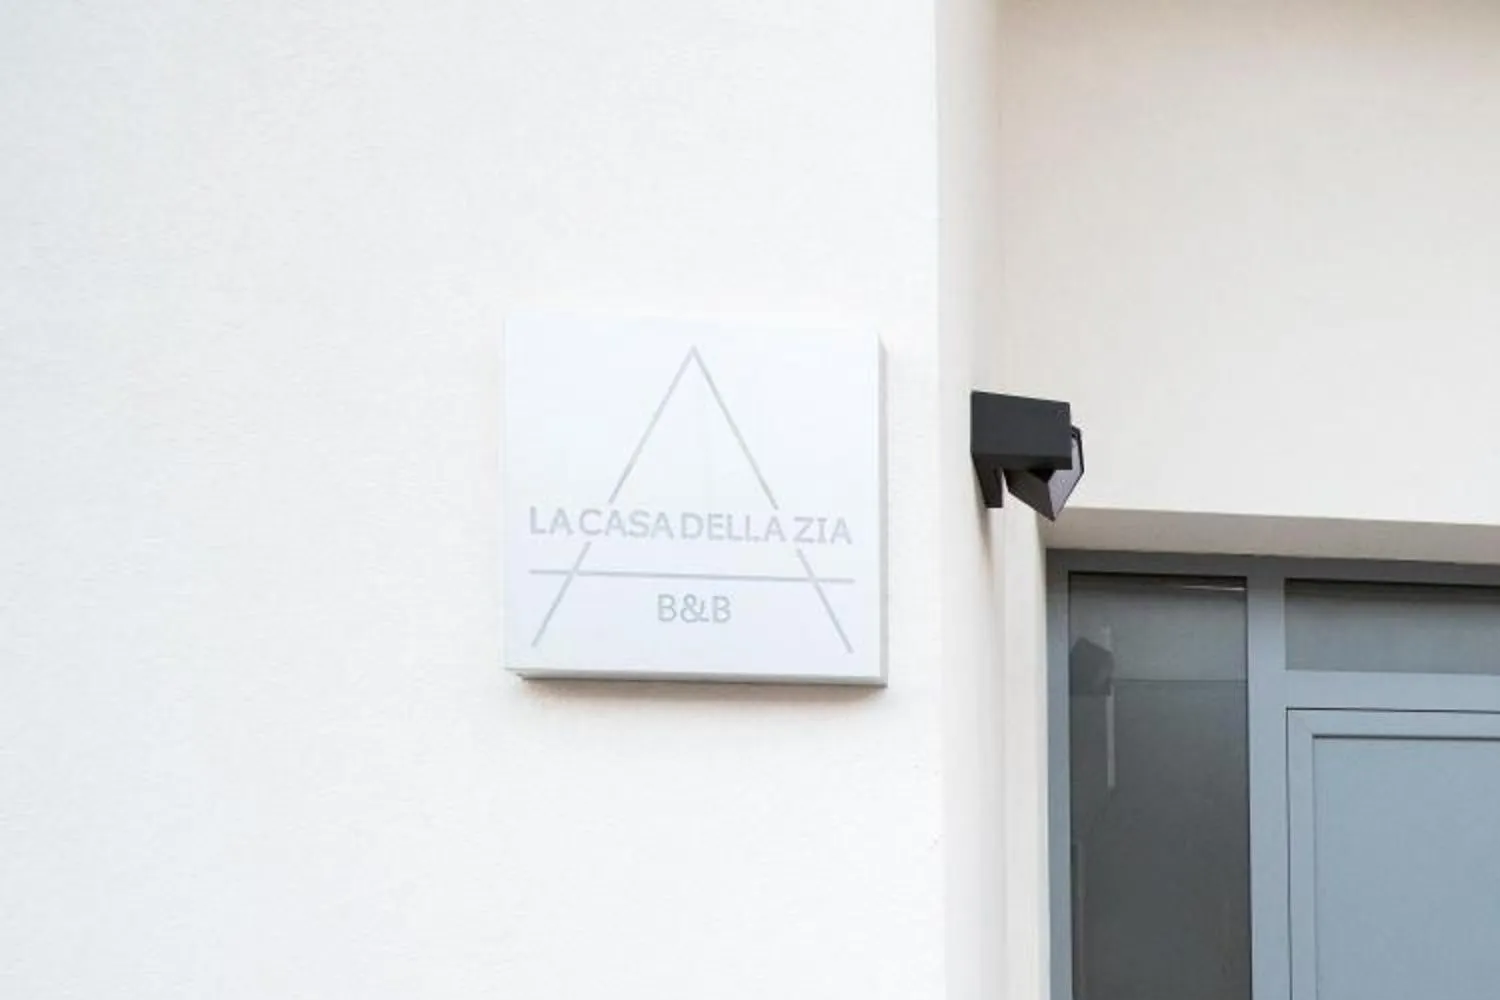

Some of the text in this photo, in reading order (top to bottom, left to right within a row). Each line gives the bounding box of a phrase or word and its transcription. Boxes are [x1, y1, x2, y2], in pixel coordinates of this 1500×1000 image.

[530, 507, 853, 544] LA CASA DELLA ZIA
[657, 594, 732, 623] B&B
